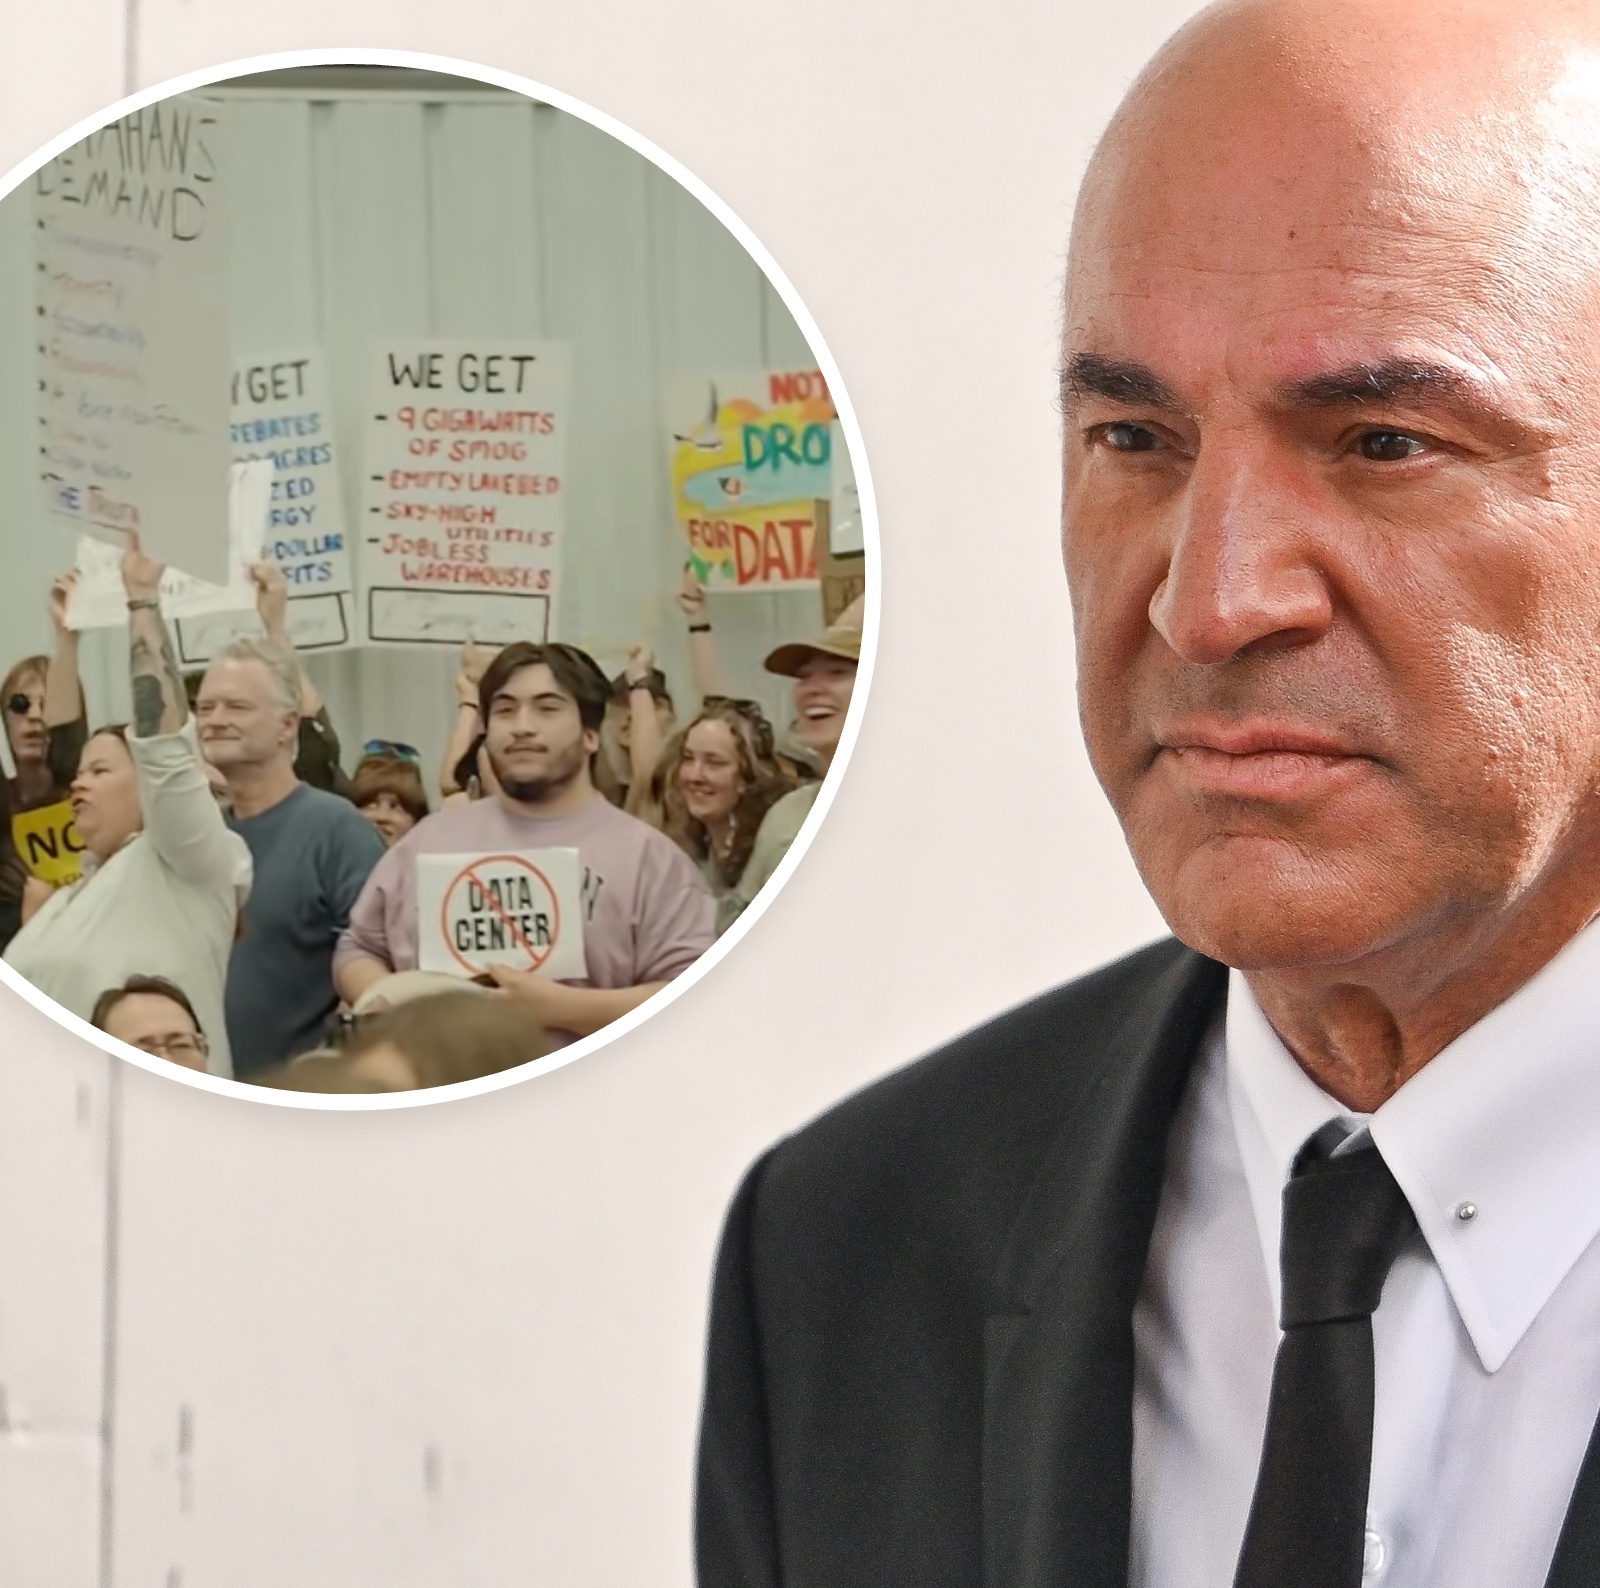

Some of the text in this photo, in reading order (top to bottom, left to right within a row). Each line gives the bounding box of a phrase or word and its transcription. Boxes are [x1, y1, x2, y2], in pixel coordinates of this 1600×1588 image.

[86, 102, 219, 182] AHANS
[246, 359, 310, 404] GET
[389, 353, 536, 394] WE GET
[397, 406, 556, 434] 9 GIGAWATTS
[408, 437, 528, 462] OF SMOG
[742, 422, 830, 472] DRO
[388, 469, 560, 496] EMPTY LAKEBED
[386, 501, 497, 524] SKY-HIGH
[382, 533, 491, 564] JOBLESS
[446, 527, 555, 547] UTILITIES
[689, 518, 731, 549] FOR
[401, 562, 552, 590] WAREHOUSES
[468, 875, 534, 913] DATA
[455, 913, 551, 952] CENTER
